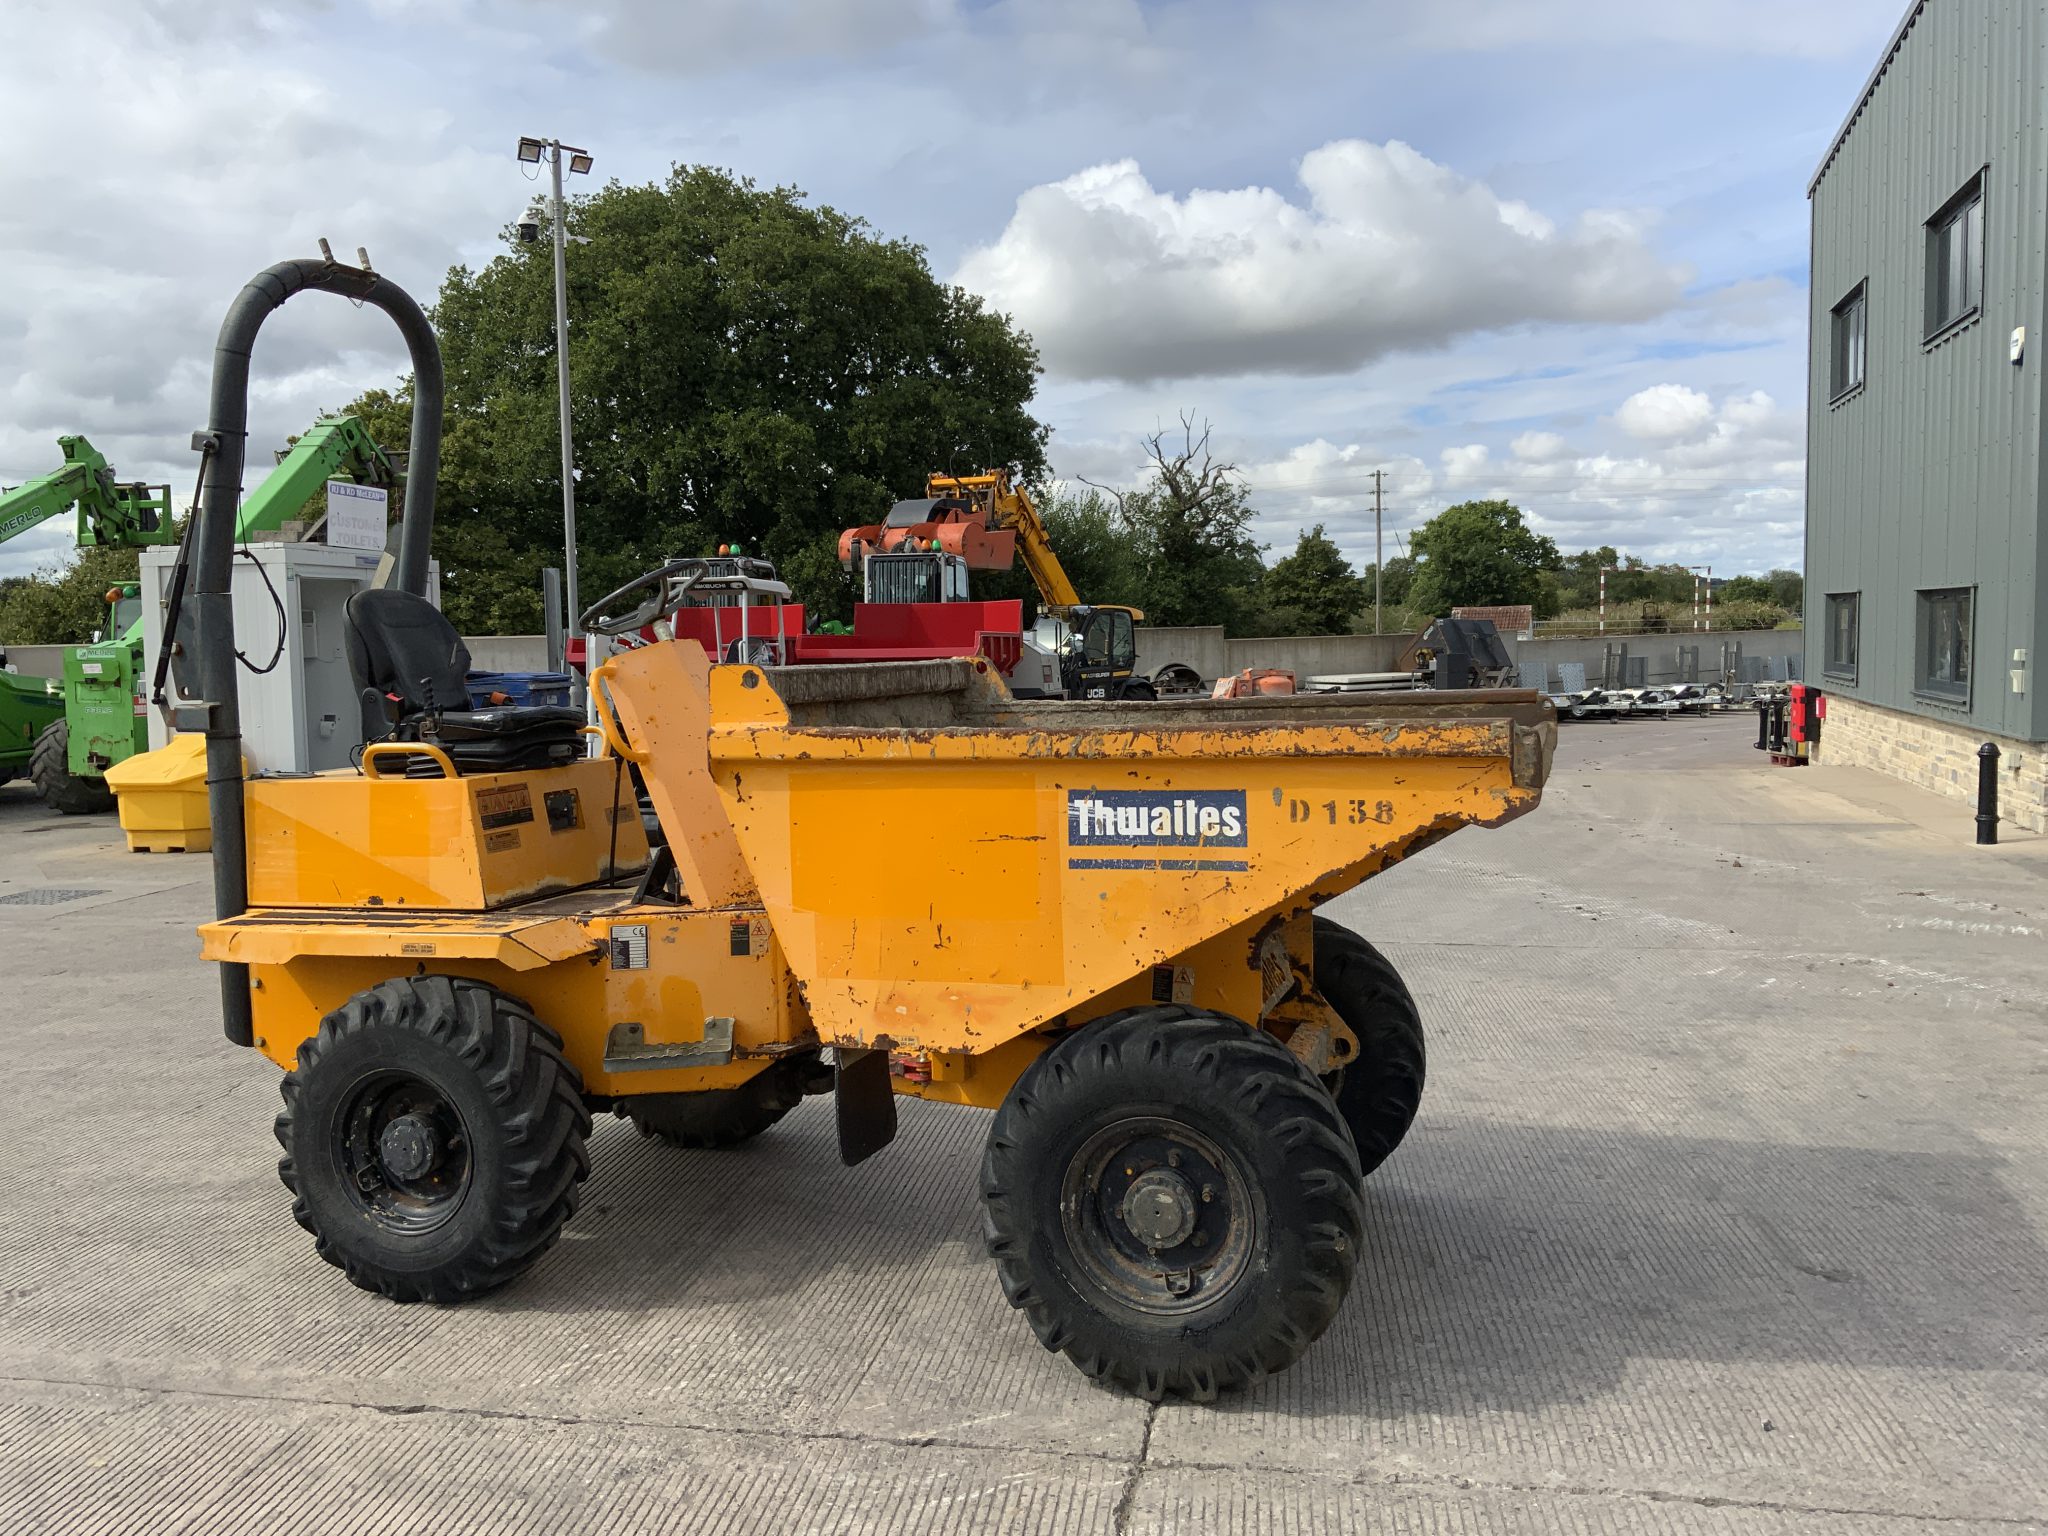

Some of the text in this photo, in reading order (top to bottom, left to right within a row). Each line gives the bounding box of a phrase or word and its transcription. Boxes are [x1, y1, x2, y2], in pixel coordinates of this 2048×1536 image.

[0, 506, 41, 535] MERLO
[336, 533, 378, 546] TOILETS
[1087, 688, 1105, 699] JCB
[1073, 799, 1241, 837] Thwaites
